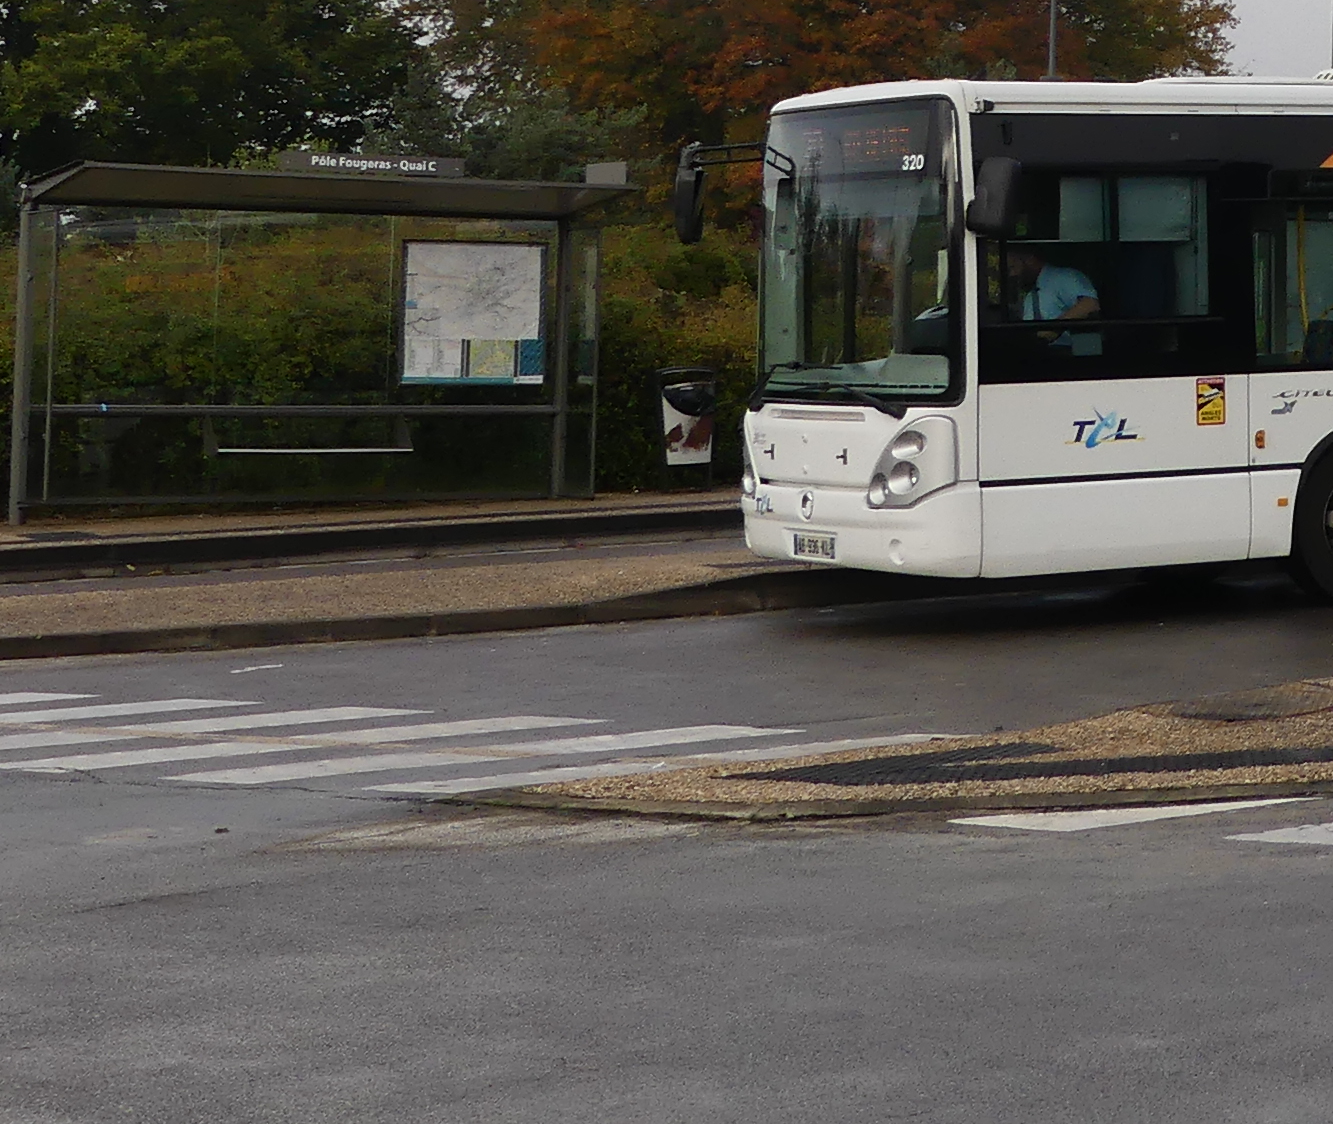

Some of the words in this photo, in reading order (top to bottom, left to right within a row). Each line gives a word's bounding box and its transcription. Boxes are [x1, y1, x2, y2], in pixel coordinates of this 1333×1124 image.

[311, 156, 337, 167] Pôle
[339, 157, 392, 171] Fougeras
[400, 160, 427, 171] Quai
[428, 162, 437, 171] C
[901, 154, 925, 171] 320
